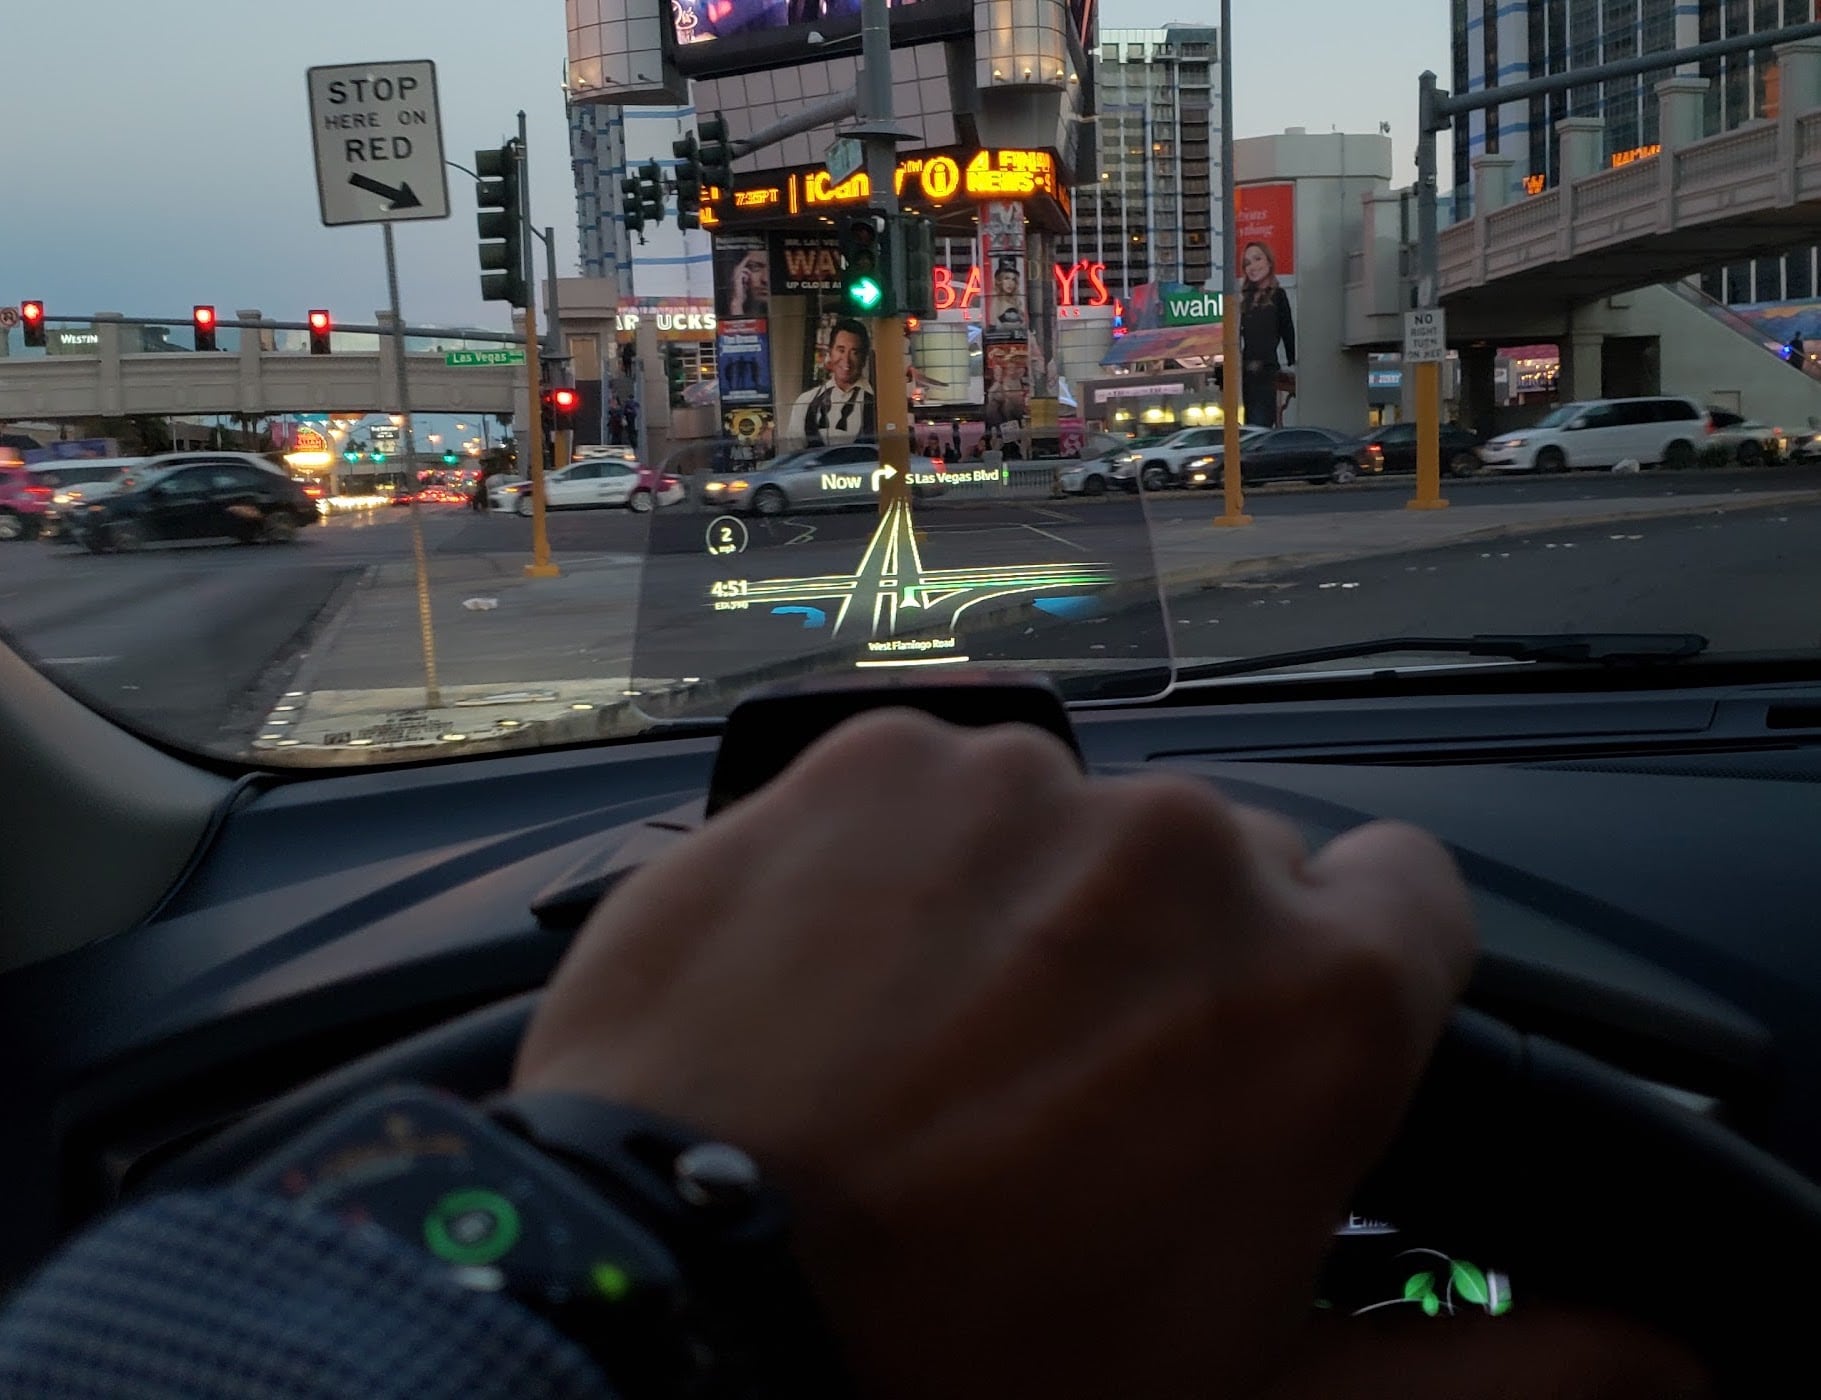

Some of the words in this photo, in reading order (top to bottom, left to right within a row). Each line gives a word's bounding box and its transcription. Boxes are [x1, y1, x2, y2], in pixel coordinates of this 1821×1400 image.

[328, 77, 418, 104] STOP
[325, 112, 381, 130] HERE
[398, 109, 427, 126] ON
[345, 136, 412, 162] RED
[1414, 313, 1433, 325] NO
[453, 352, 473, 363] Las
[475, 351, 507, 364] Vegas
[821, 473, 862, 490] Now
[905, 473, 915, 485] S
[916, 472, 936, 484] Las
[936, 471, 972, 485] Vegas
[973, 468, 999, 481] Blvd
[720, 527, 733, 542] 2
[711, 579, 748, 598] 4:51
